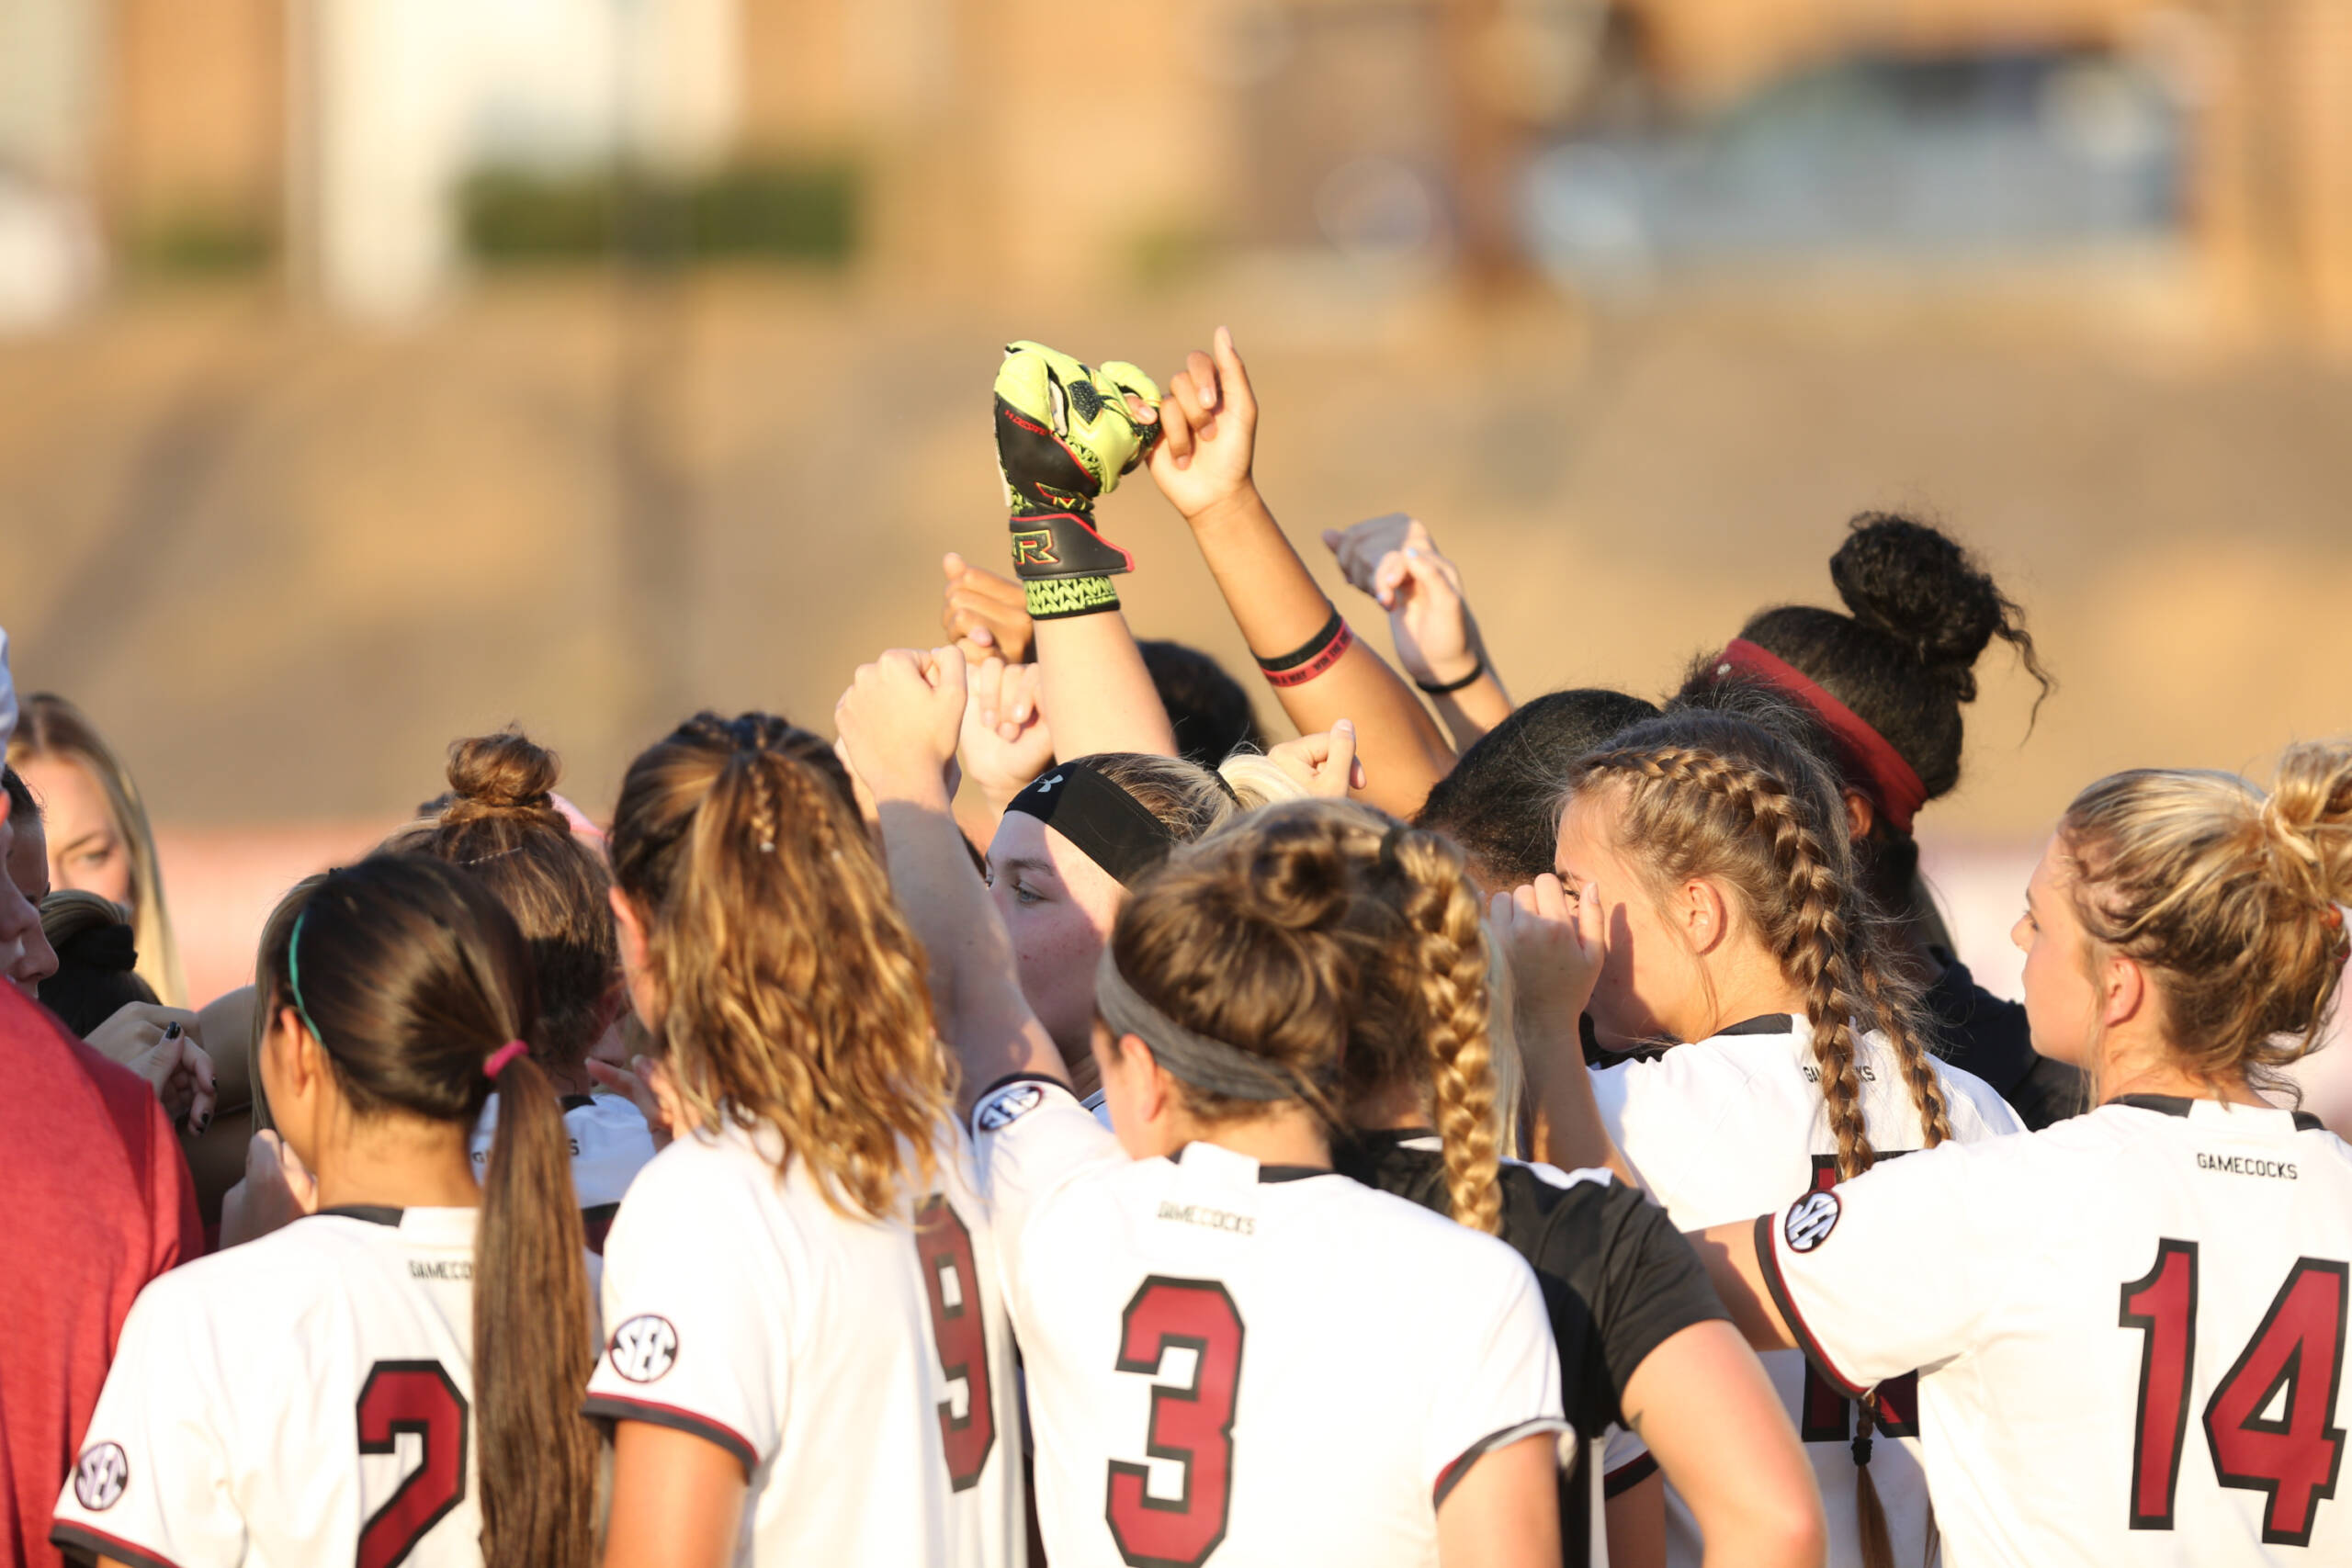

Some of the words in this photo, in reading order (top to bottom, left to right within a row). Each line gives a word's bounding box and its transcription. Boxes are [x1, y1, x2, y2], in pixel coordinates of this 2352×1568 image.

[2197, 1152, 2298, 1180] GAMECOCKS
[1785, 1190, 1841, 1252] SEC
[408, 1259, 473, 1280] GAMECO
[610, 1315, 677, 1382] SEC
[913, 1192, 996, 1494] 9
[1105, 1274, 1245, 1568] 3
[2119, 1237, 2350, 1548] 14
[75, 1442, 128, 1511] SEC
[356, 1360, 469, 1568] 2
